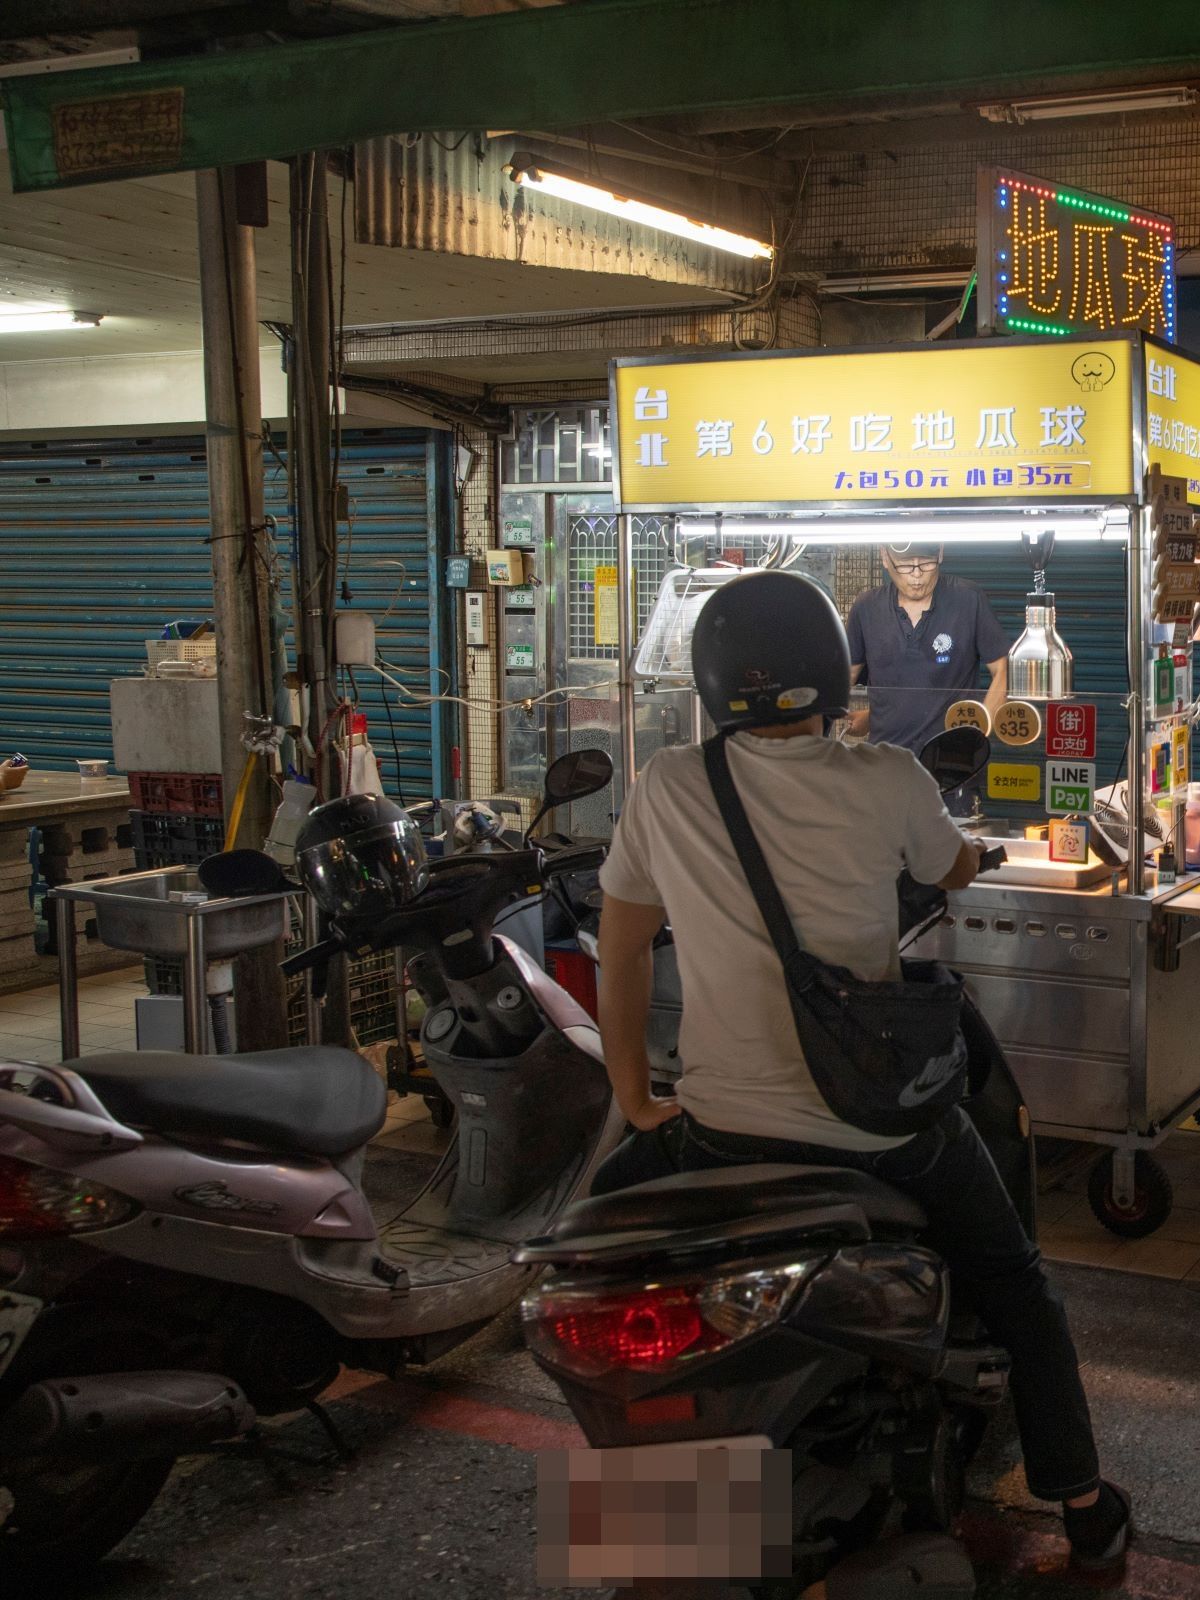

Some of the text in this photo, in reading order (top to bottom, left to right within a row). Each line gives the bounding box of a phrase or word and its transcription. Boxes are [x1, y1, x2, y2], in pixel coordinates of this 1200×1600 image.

[1006, 190, 1167, 334] 地瓜球
[1149, 359, 1177, 400] 台北
[634, 387, 669, 467] 台北
[695, 405, 1086, 458] 第6好吃地瓜球
[834, 465, 1073, 489] 大包50元 小包35元
[513, 532, 523, 541] 55
[1165, 543, 1194, 560] 巧克力味
[516, 595, 525, 604] 55
[516, 656, 525, 665] 55
[957, 707, 976, 717] 大包
[1006, 708, 1026, 719] 小包
[1000, 721, 1030, 737] $35
[1060, 711, 1080, 732] 街
[1053, 738, 1088, 751] 口支付
[993, 776, 1018, 787] 全支付
[1052, 767, 1088, 783] LINE
[1055, 790, 1087, 809] Pay
